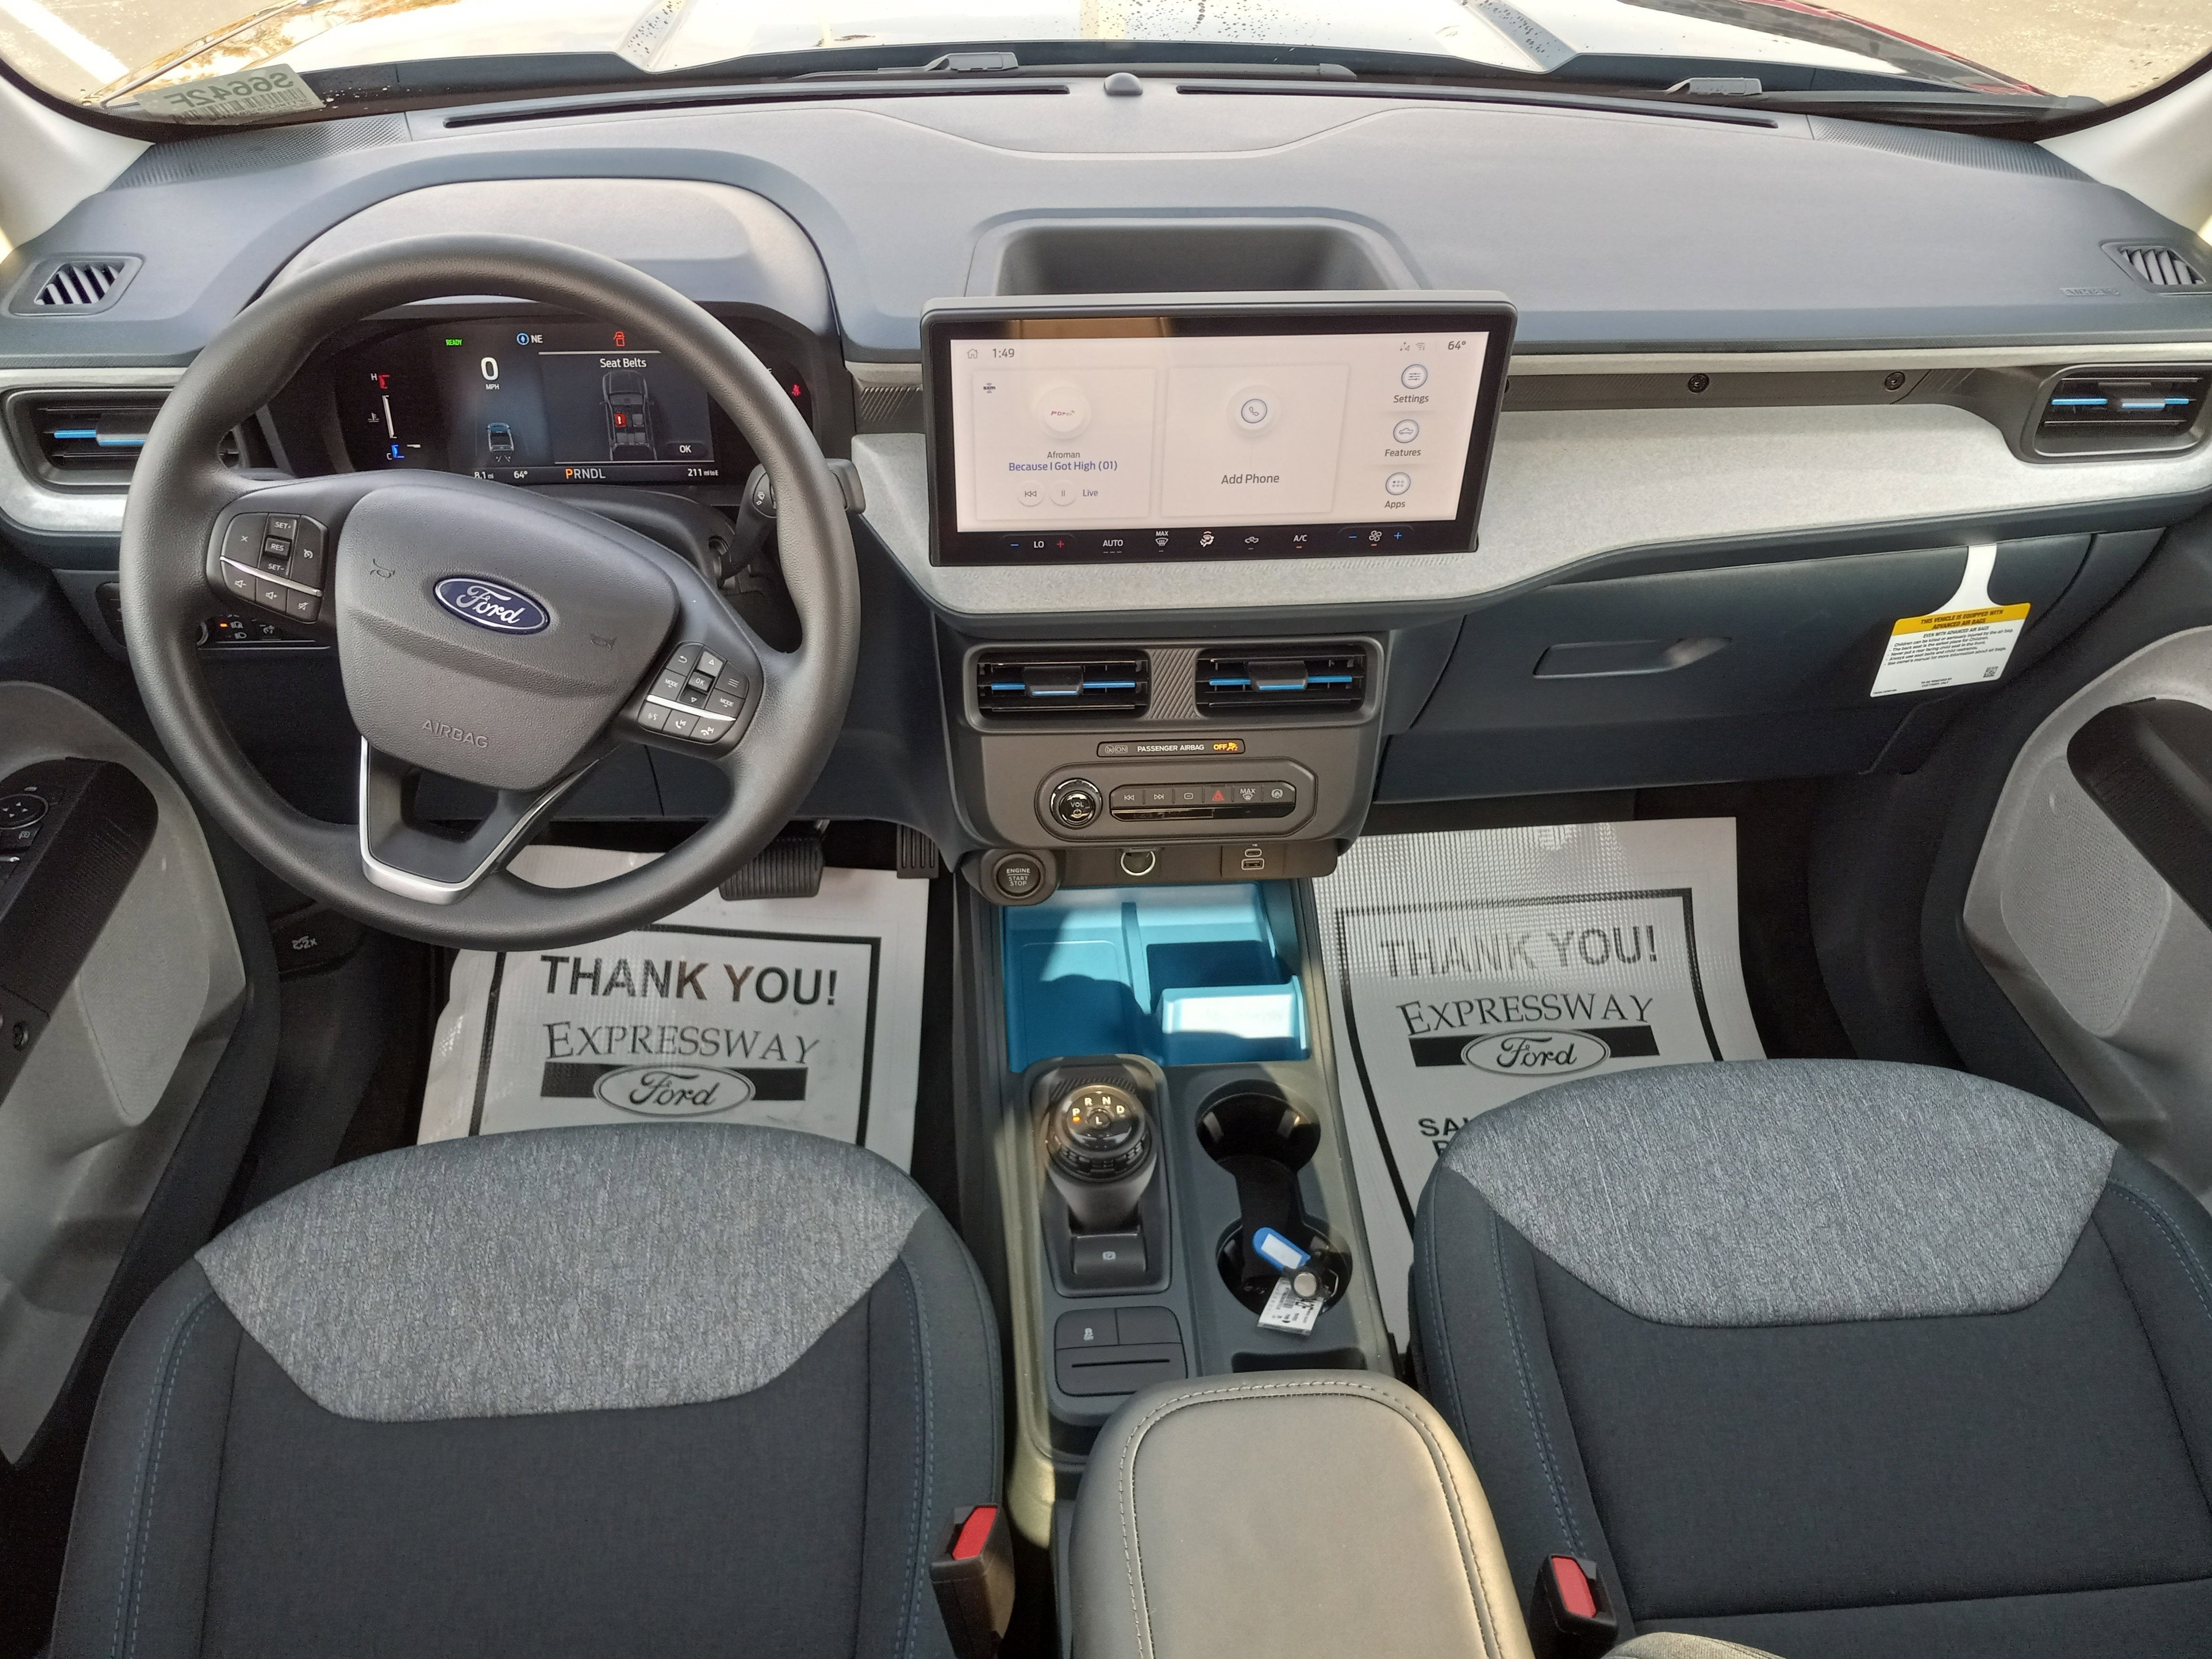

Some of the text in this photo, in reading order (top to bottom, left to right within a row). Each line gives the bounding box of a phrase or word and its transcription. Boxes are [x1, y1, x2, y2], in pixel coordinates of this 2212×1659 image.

[531, 335, 543, 343] NE
[992, 348, 1015, 358] 1:49
[600, 358, 647, 368] Seat Belts
[481, 357, 499, 381] 0
[1393, 394, 1429, 404] Settings
[679, 445, 692, 453] OK
[386, 452, 393, 460] C
[1009, 461, 1118, 471] Because I Got High (01)
[514, 470, 528, 479] 64°
[687, 468, 702, 477] 211
[1221, 474, 1279, 484] Add Phone
[1384, 501, 1406, 509] Apps
[270, 543, 285, 552] RES
[456, 584, 526, 625] Ford
[1962, 611, 1988, 620] EQUIPPED
[1932, 621, 1961, 629] ADVANCED
[664, 678, 679, 688] MODE
[696, 677, 706, 685] OK
[720, 697, 734, 708] MODE
[421, 719, 489, 749] AIRBAG
[1380, 924, 1658, 978] THANK YOU!
[541, 955, 838, 1006] THANK YOU!
[1396, 993, 1654, 1036] EXPRESSWAY
[542, 1021, 821, 1064] EXPRESSWAY
[1496, 1036, 1577, 1069] Ford
[629, 1070, 720, 1107] Ford
[1084, 1097, 1093, 1106] R
[1102, 1096, 1111, 1105] N
[1072, 1108, 1081, 1116] P
[1116, 1105, 1125, 1115] D
[1095, 1116, 1103, 1125] L
[1418, 1117, 1469, 1137] SA
